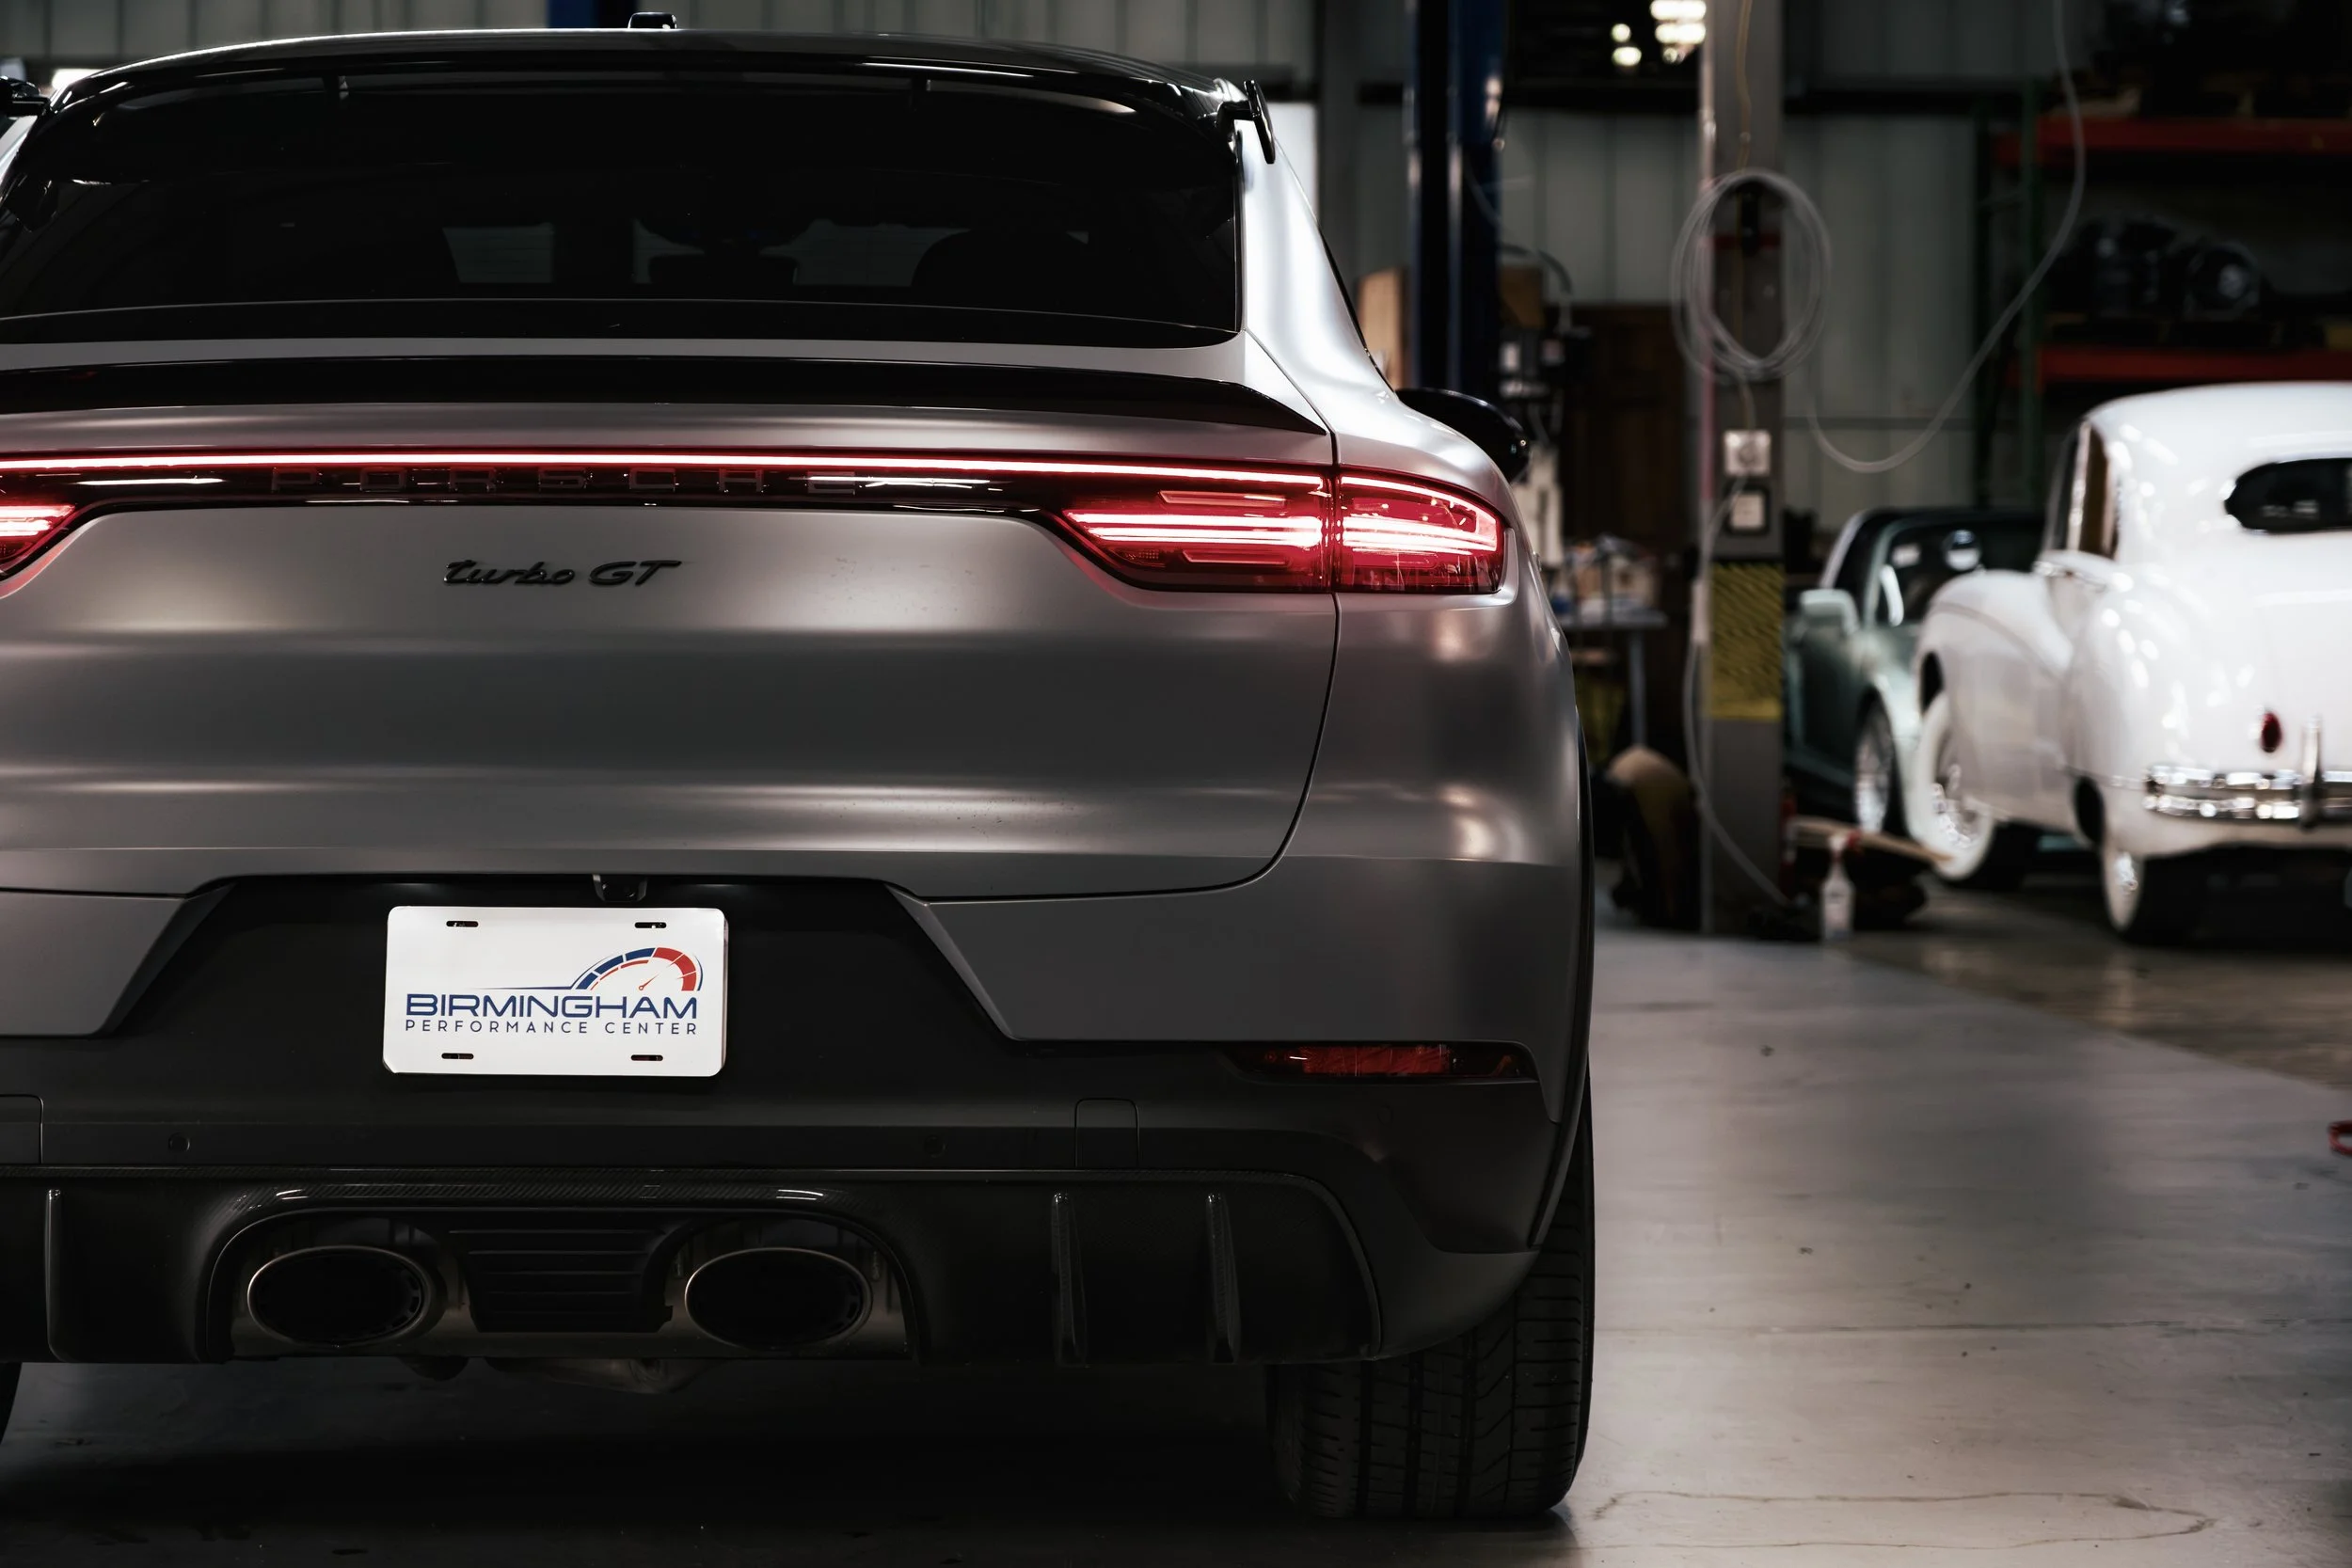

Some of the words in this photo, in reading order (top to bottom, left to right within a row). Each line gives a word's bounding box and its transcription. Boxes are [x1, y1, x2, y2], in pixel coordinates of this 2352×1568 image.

[271, 467, 856, 494] PORSCHE
[444, 560, 575, 585] turbo
[589, 561, 682, 586] GT
[405, 993, 697, 1019] BIRMINGHAM
[405, 1020, 588, 1034] PERFORMANCE
[605, 1022, 696, 1035] CENTER
